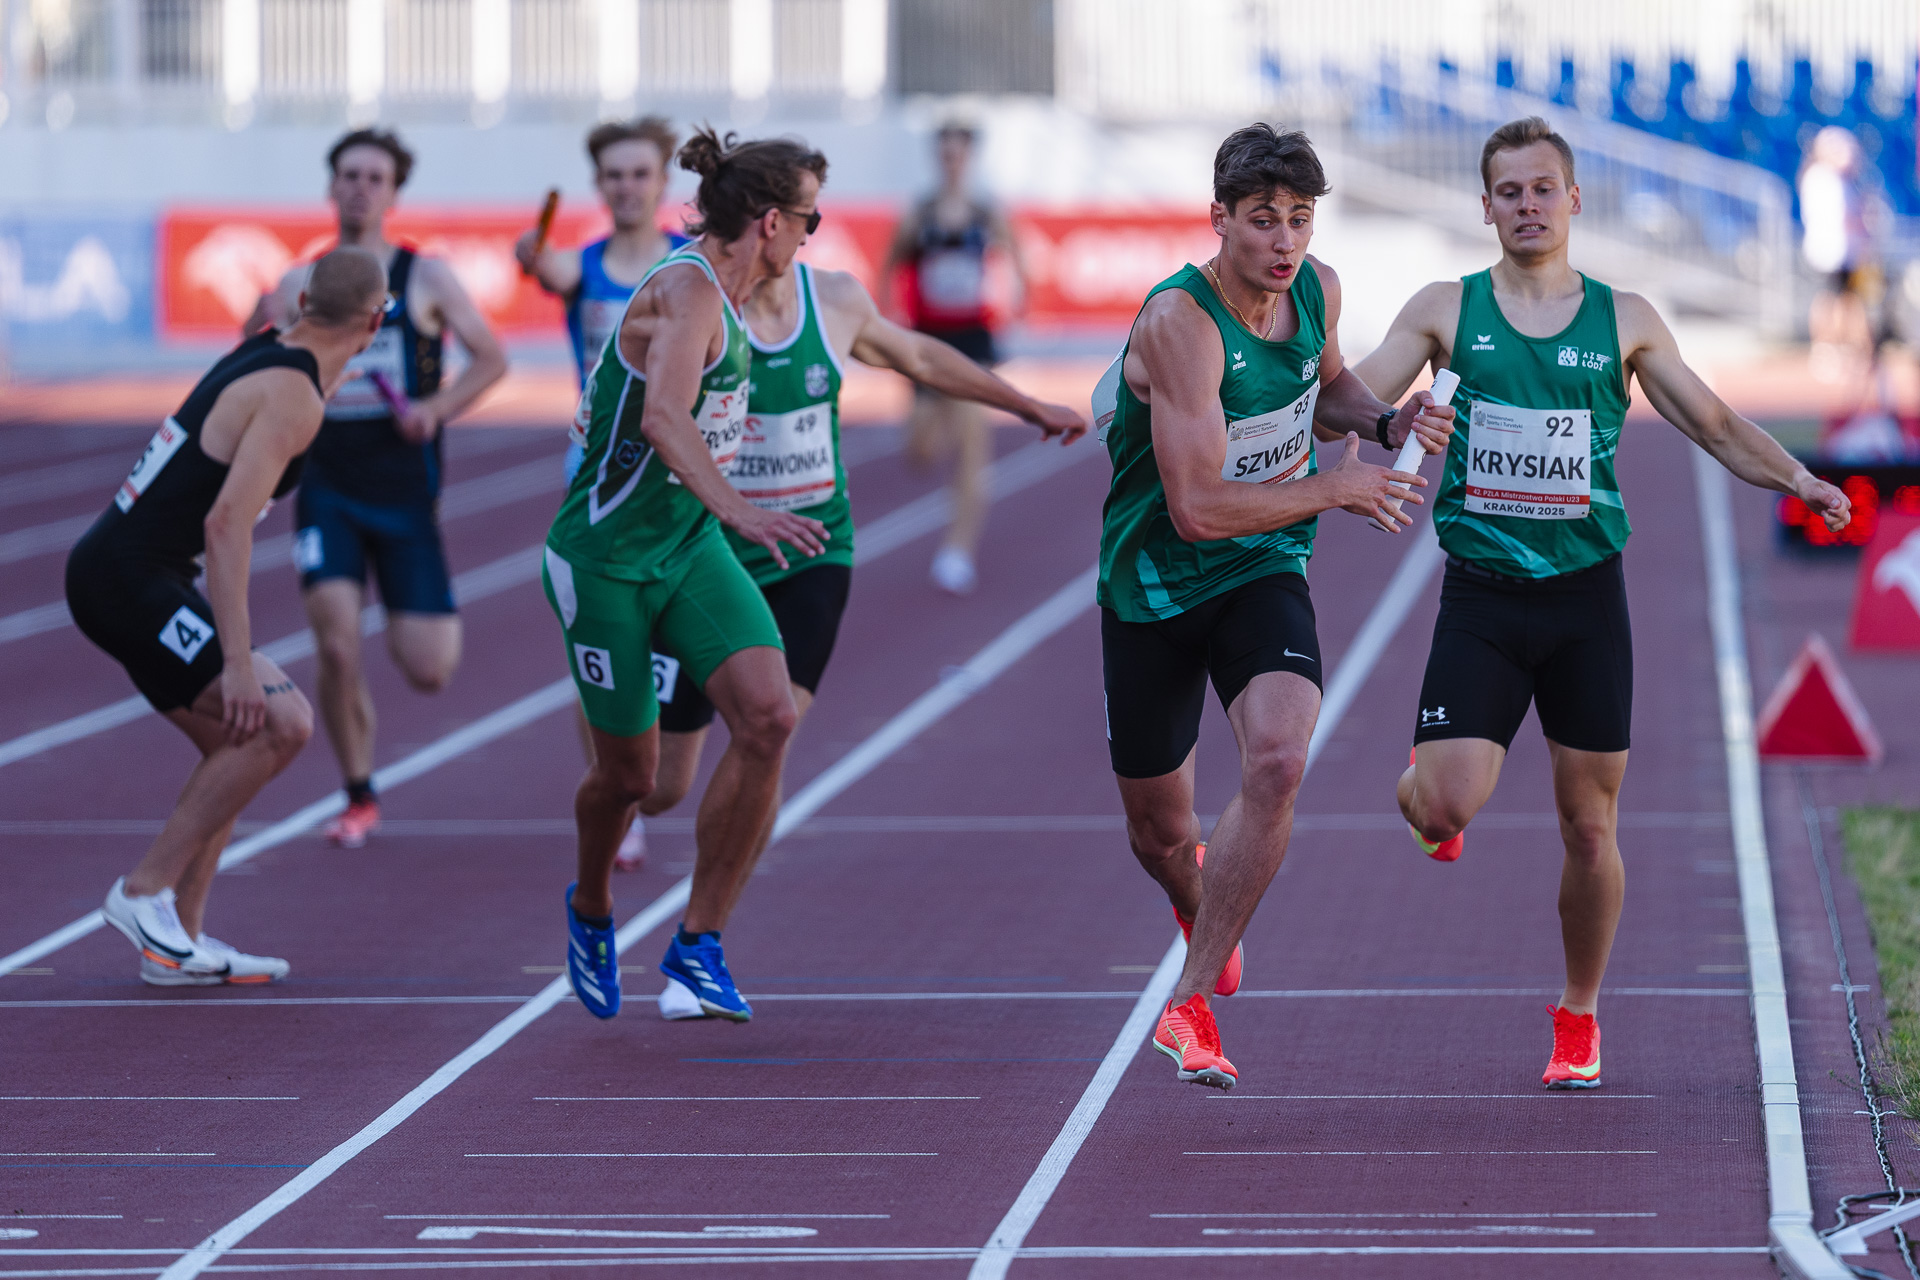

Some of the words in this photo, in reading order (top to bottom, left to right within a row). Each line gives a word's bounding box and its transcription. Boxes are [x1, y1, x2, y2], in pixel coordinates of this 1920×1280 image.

[1293, 394, 1310, 422] 93
[794, 412, 817, 433] 49
[1545, 416, 1574, 437] 92
[1234, 429, 1305, 478] SZWED
[1472, 447, 1586, 480] KRYSIAK
[1483, 490, 1499, 498] PZLA
[1501, 492, 1543, 502] Mistrzostwa
[1544, 495, 1565, 503] Polski
[1484, 502, 1535, 515] KRAKÓW
[1537, 507, 1565, 516] 2025
[175, 620, 202, 650] 4
[583, 650, 604, 683] 6
